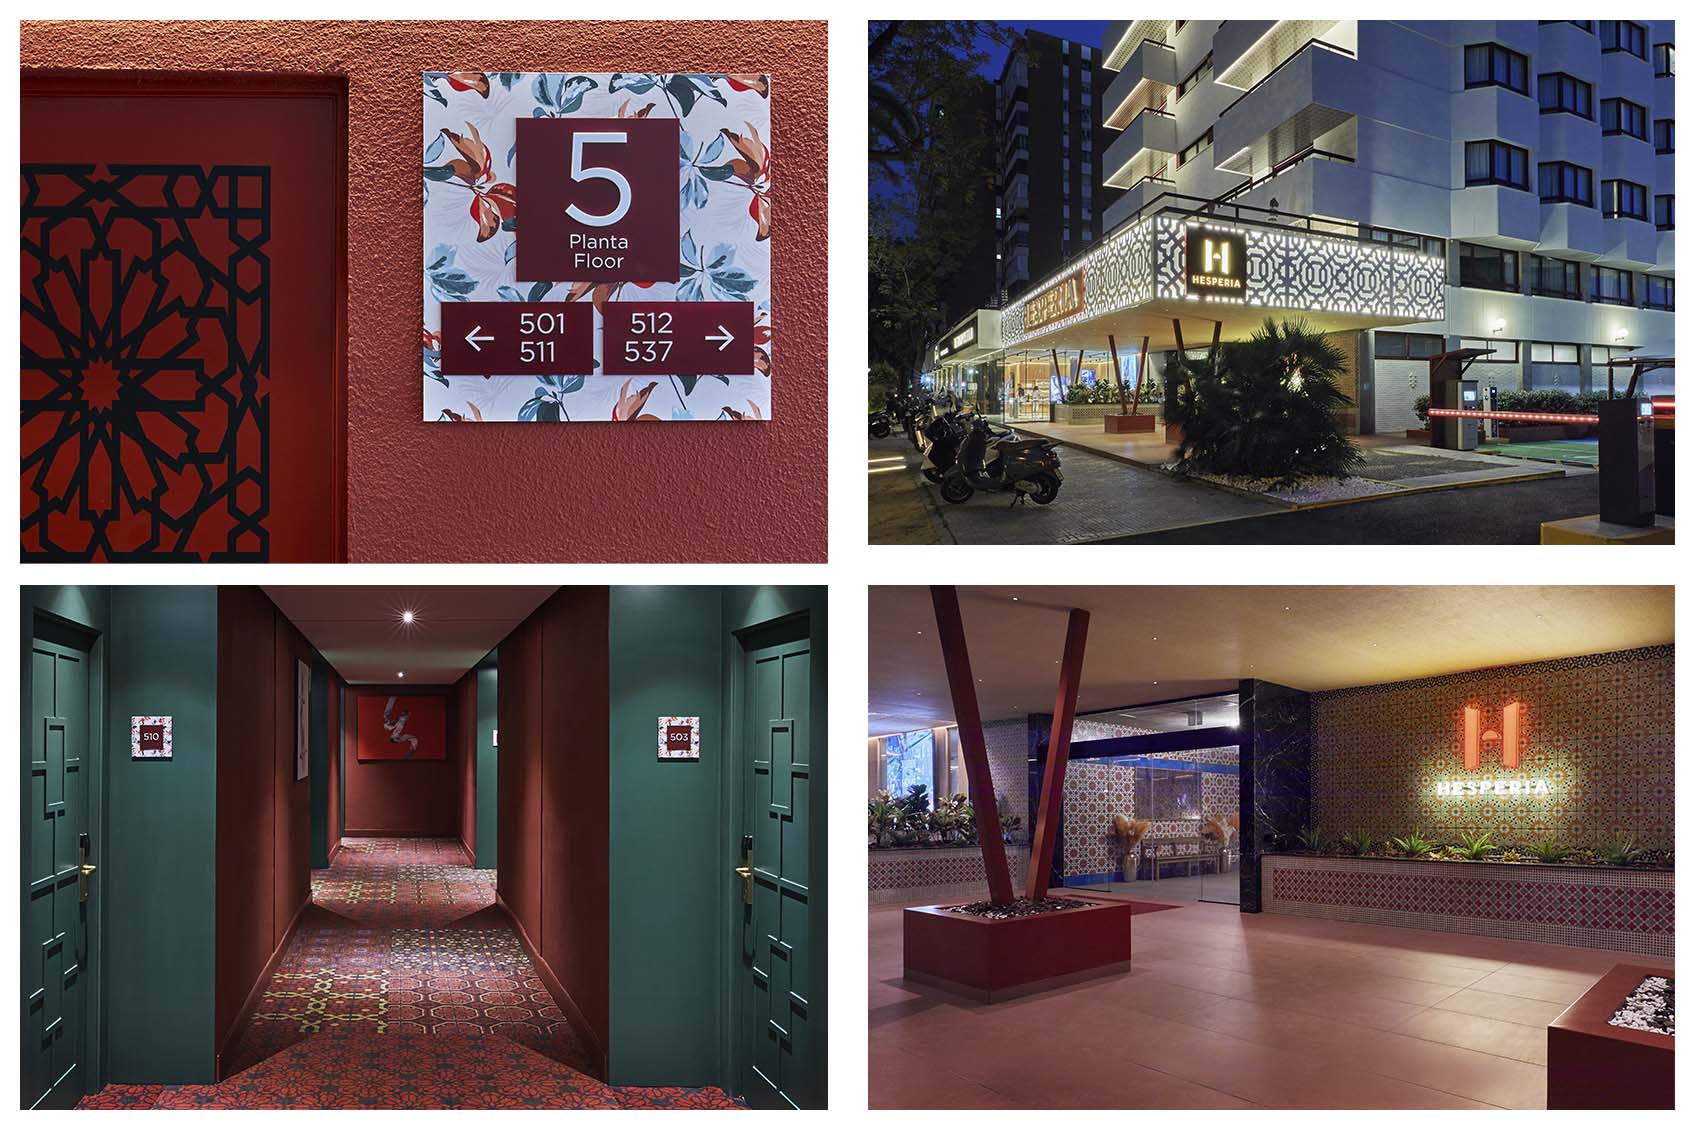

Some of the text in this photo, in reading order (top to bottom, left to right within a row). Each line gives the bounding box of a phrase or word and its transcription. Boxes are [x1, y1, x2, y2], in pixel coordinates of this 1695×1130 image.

[564, 131, 632, 227] 5
[569, 233, 628, 250] Planta
[574, 253, 624, 269] Floor
[1192, 275, 1241, 289] HESPERIA
[519, 312, 565, 335] 501
[630, 312, 673, 335] 512
[519, 341, 555, 362] 511
[624, 341, 673, 362] 537
[143, 732, 160, 741] 510
[670, 732, 689, 742] 503
[1437, 780, 1550, 796] HESPERIA
